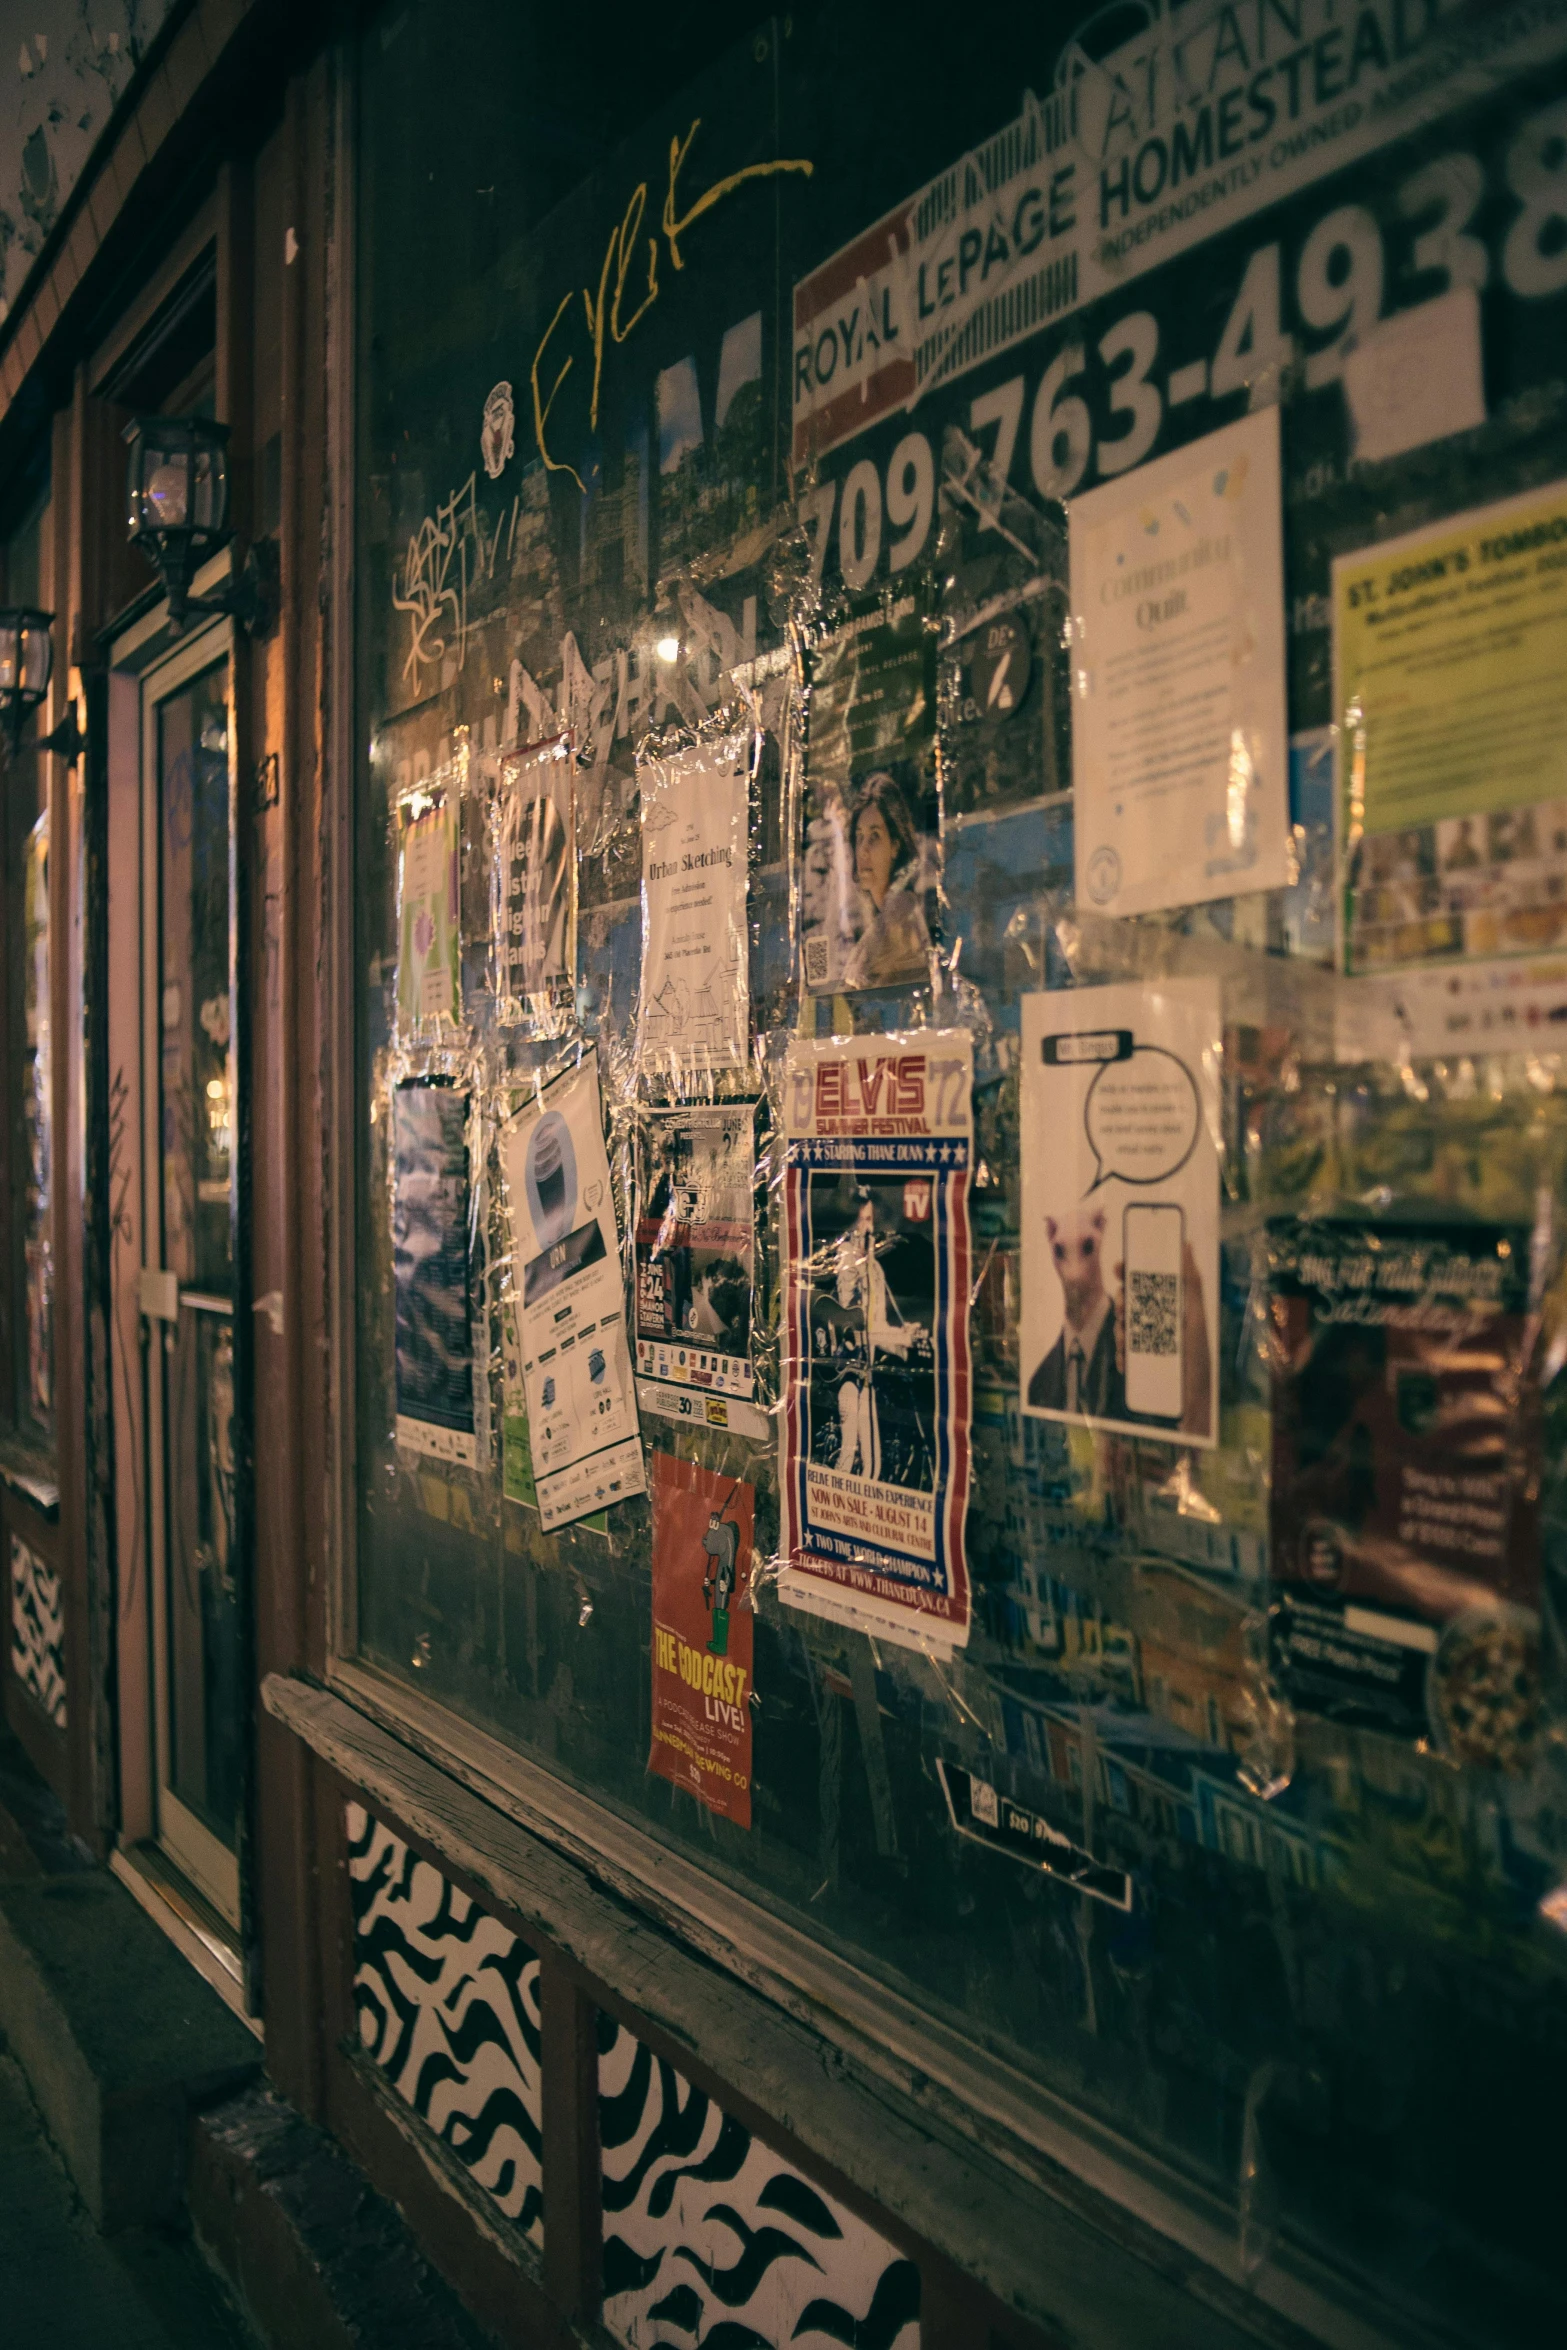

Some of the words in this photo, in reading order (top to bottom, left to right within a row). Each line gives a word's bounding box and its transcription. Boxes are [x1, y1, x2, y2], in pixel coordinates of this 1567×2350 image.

[797, 289, 898, 394] ROYAL
[650, 860, 678, 881] Urban
[681, 845, 733, 872] Sketching
[815, 1055, 926, 1117] ELVIS
[816, 1117, 868, 1136] SUMMER
[872, 1116, 931, 1136] FESTIVAL
[824, 1143, 866, 1162] STARRING
[647, 1276, 664, 1300] 24
[831, 1475, 845, 1491] THE
[845, 1479, 862, 1497] FULL
[864, 1484, 884, 1501] ELVIS
[885, 1488, 933, 1514] EXPERIENCE
[811, 1487, 831, 1505] NOW
[832, 1491, 846, 1510] ON
[846, 1495, 868, 1516] SALE
[874, 1503, 911, 1529] AUGUST
[914, 1515, 928, 1533] 14
[815, 1533, 833, 1552] TWO
[836, 1564, 847, 1581] AT
[654, 1626, 678, 1674] THE
[704, 1696, 745, 1734] LIVE!
[717, 1728, 740, 1746] SHOW
[733, 1772, 748, 1791] CO
